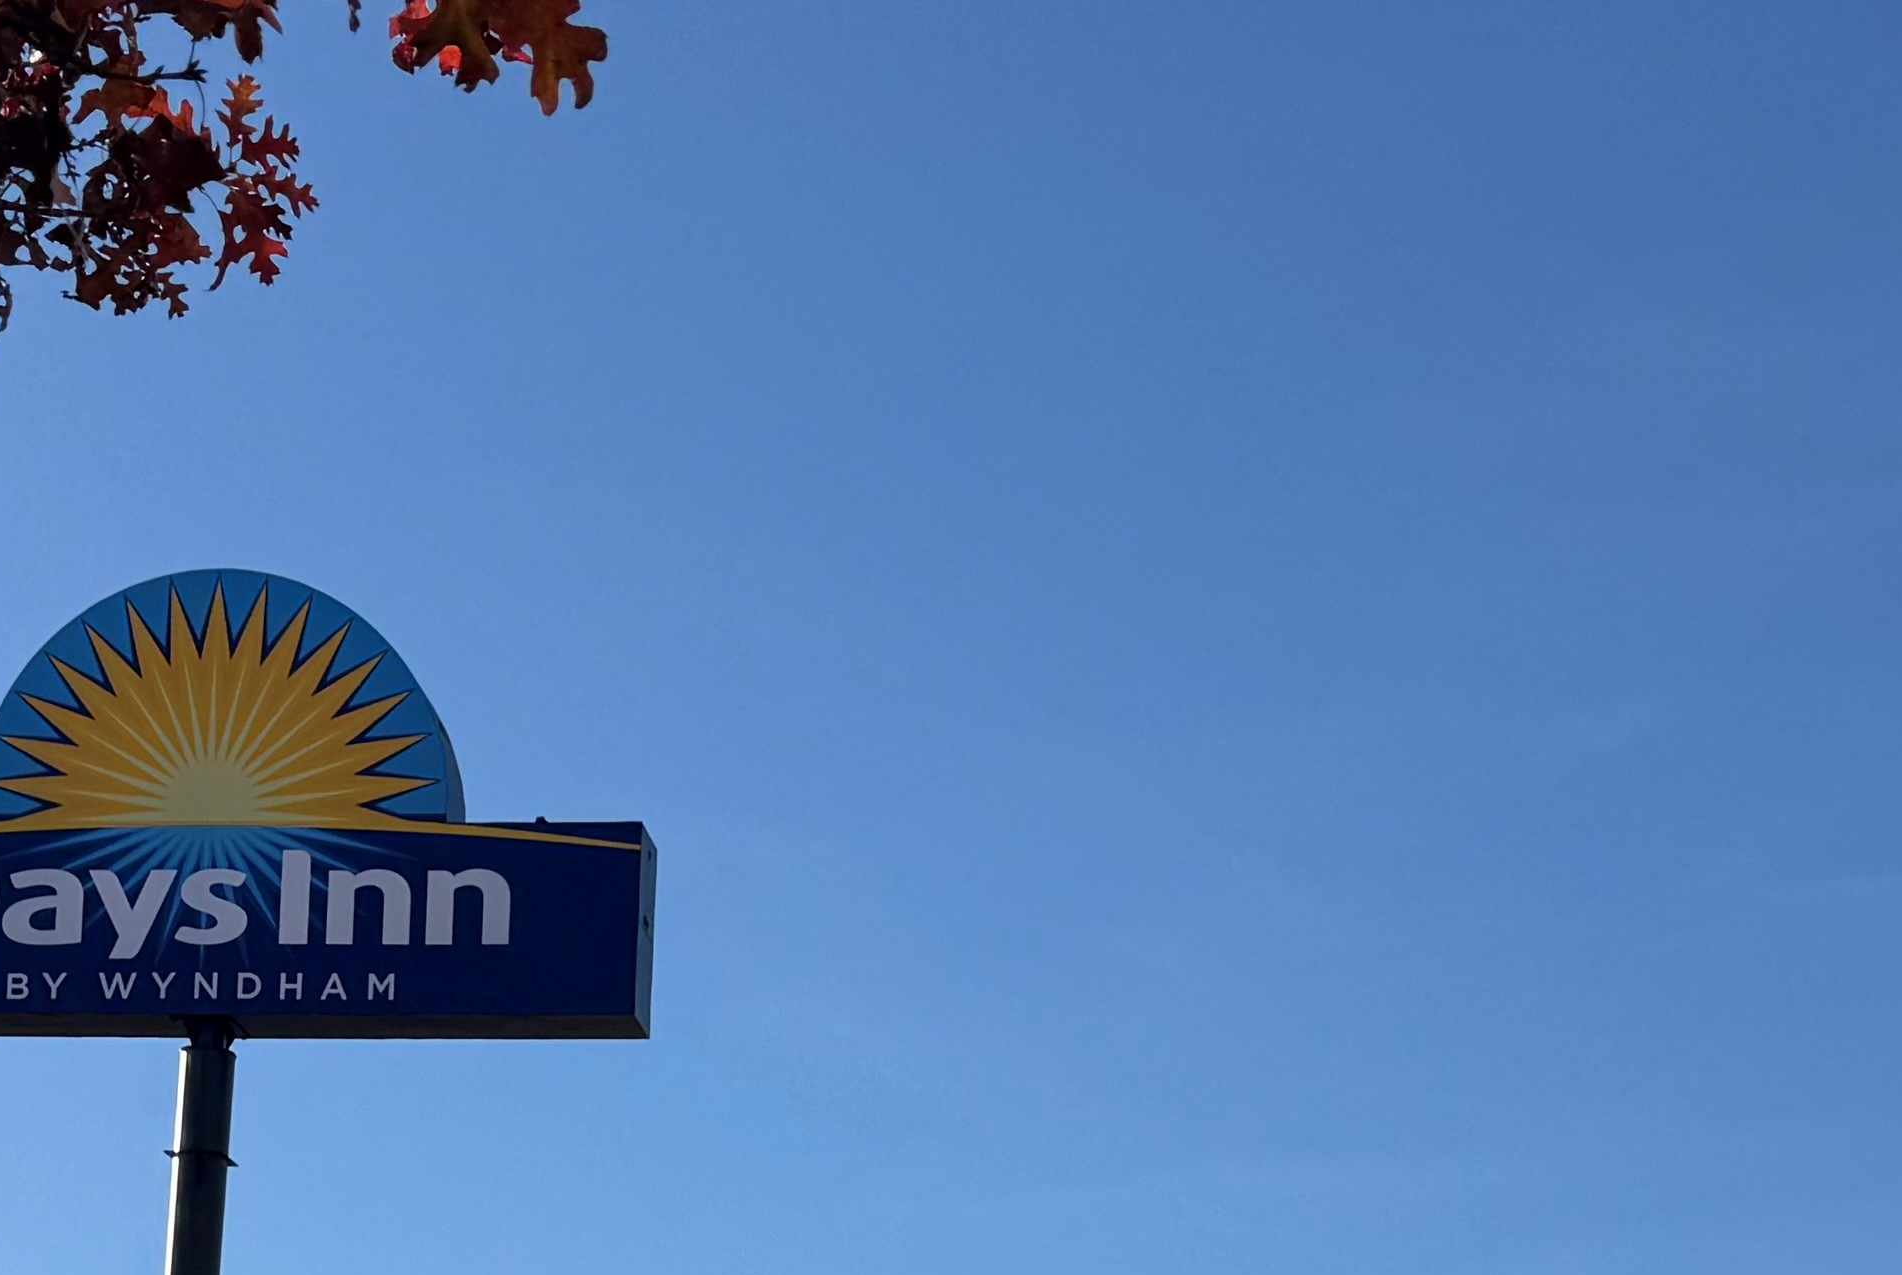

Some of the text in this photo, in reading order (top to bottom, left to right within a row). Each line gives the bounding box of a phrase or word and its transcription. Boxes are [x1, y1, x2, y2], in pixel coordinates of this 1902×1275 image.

[278, 848, 512, 946] Inn
[5, 972, 396, 1001] BY WYNDHAM
